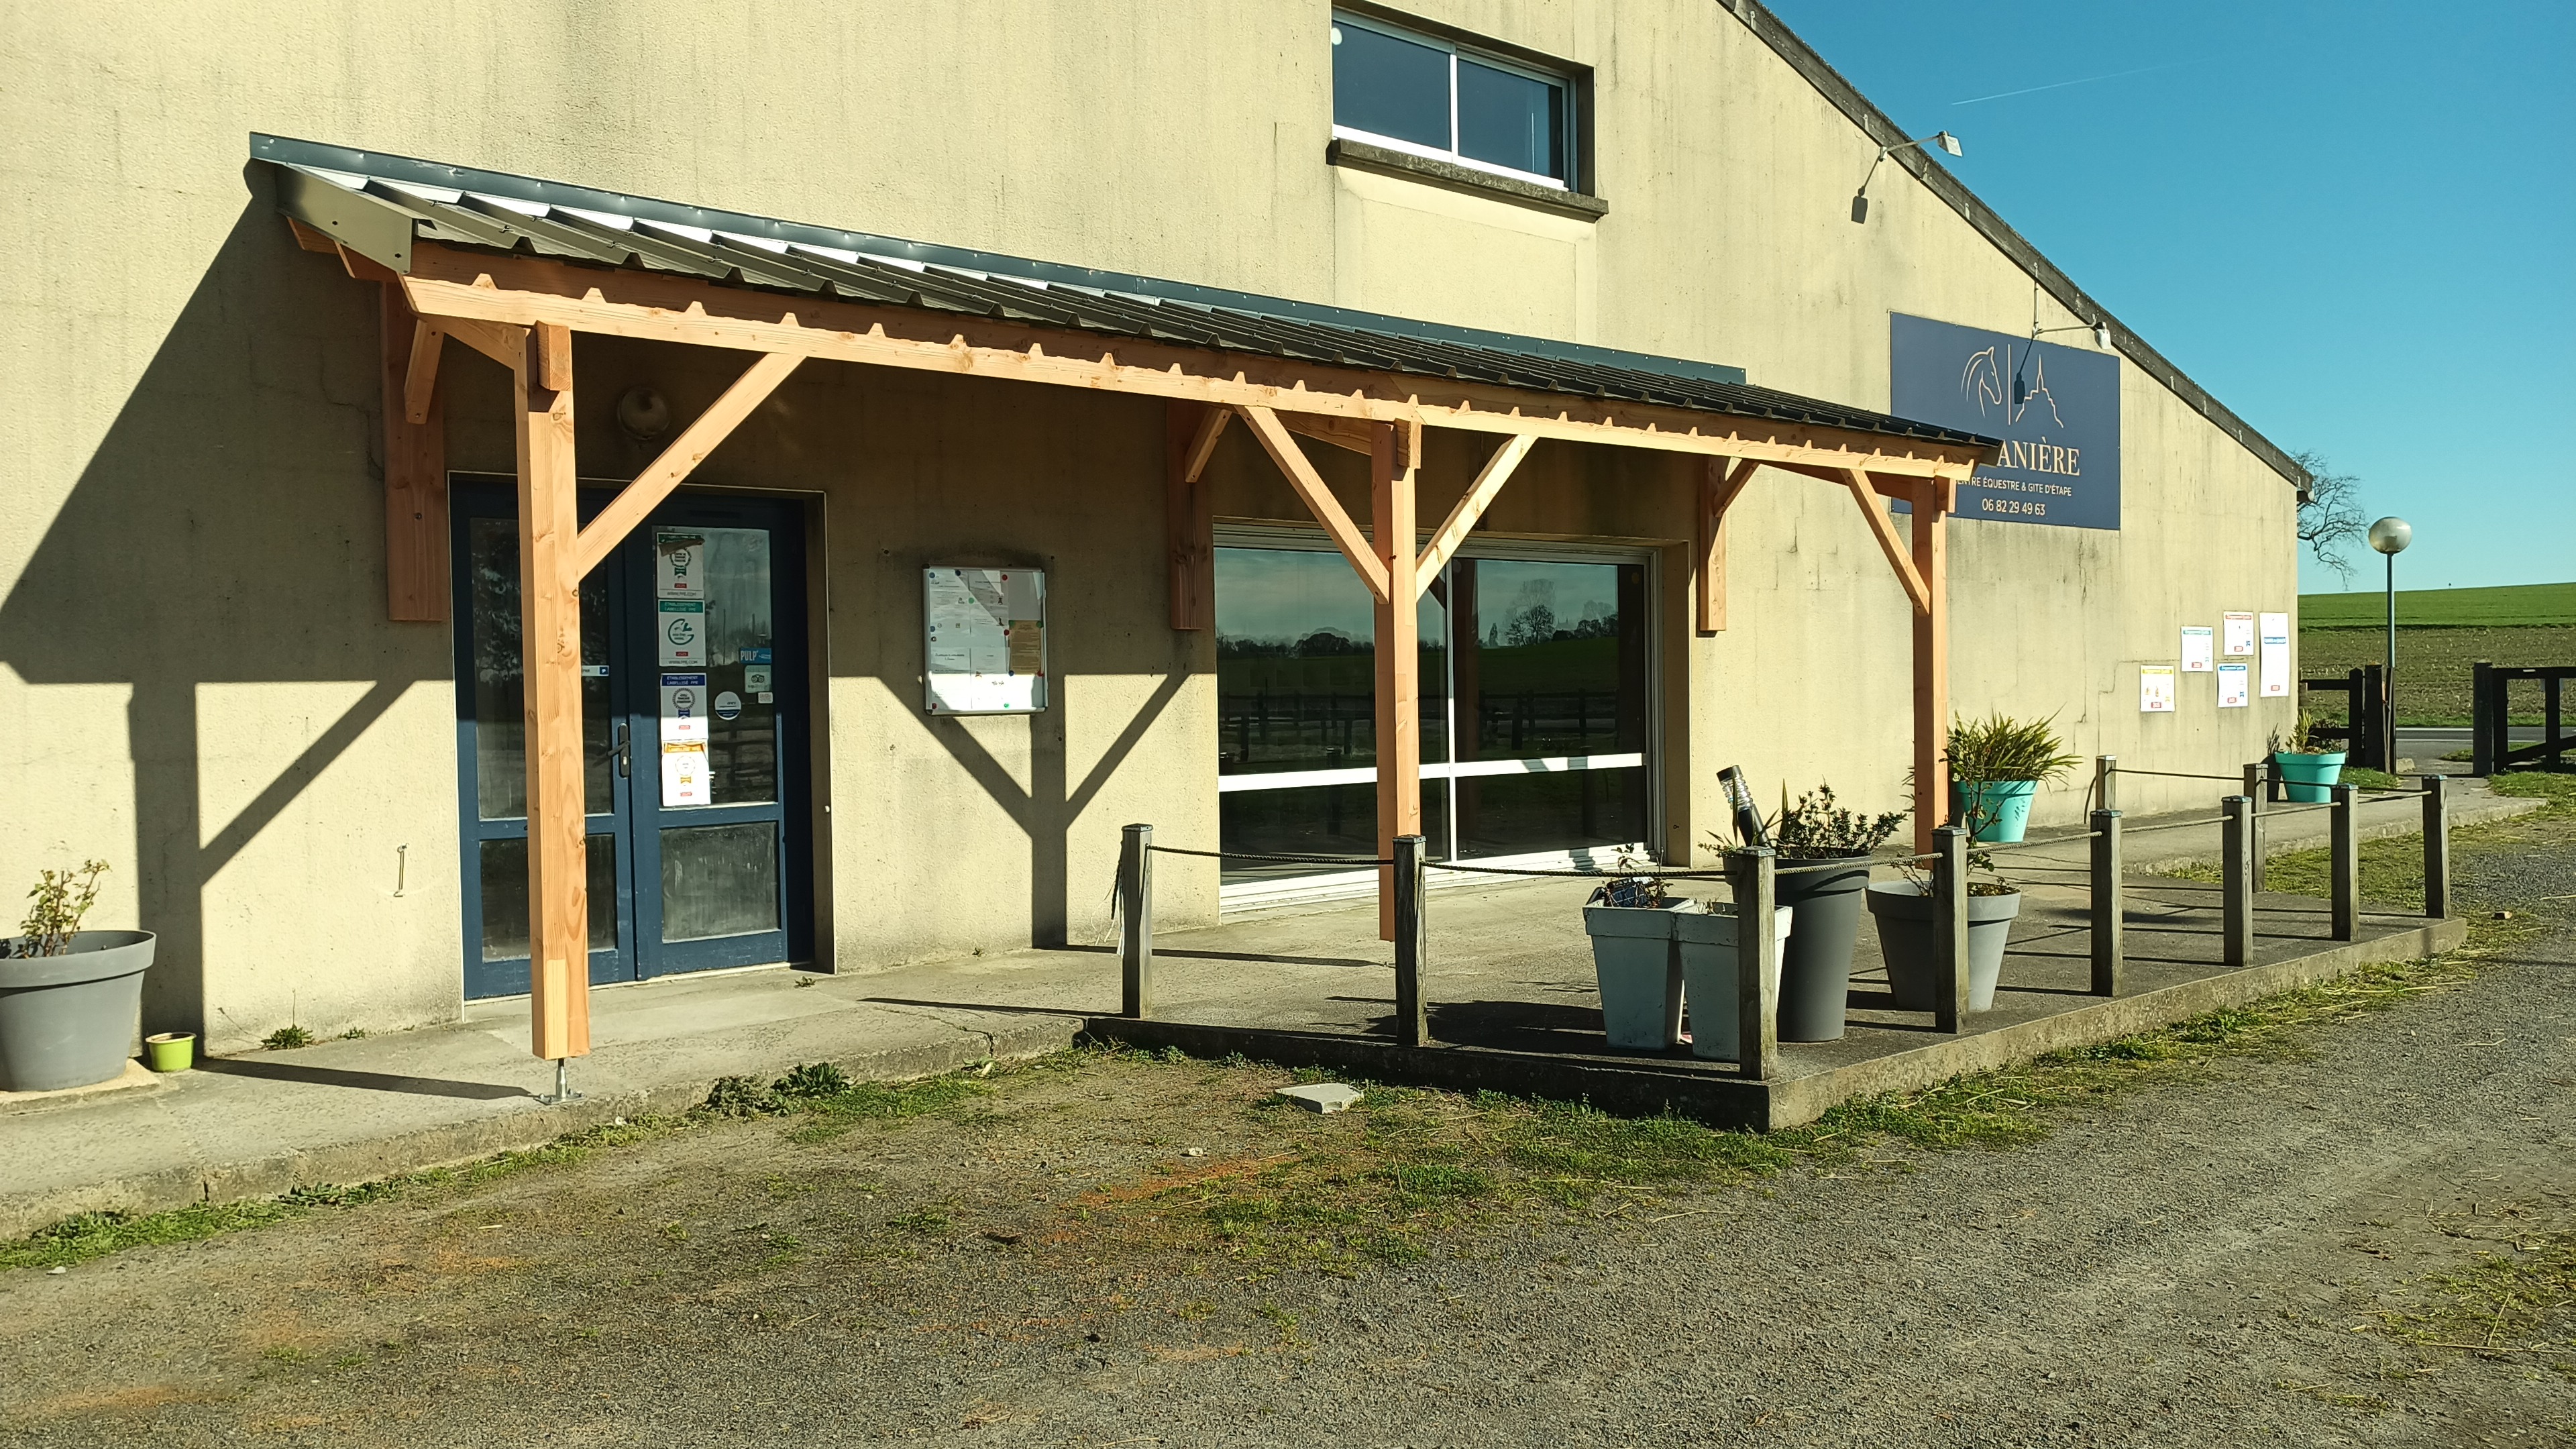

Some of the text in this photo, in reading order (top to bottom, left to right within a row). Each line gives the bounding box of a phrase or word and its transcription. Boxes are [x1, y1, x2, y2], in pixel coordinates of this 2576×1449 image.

[1996, 437, 2080, 476] ANIÈRE
[1983, 476, 2020, 490] ÉQUESTRE
[2022, 482, 2027, 491] &
[2028, 483, 2043, 494] GITE
[2045, 484, 2072, 496] D'ÉTAPE
[1982, 498, 2045, 516] 06 82 29 49 63
